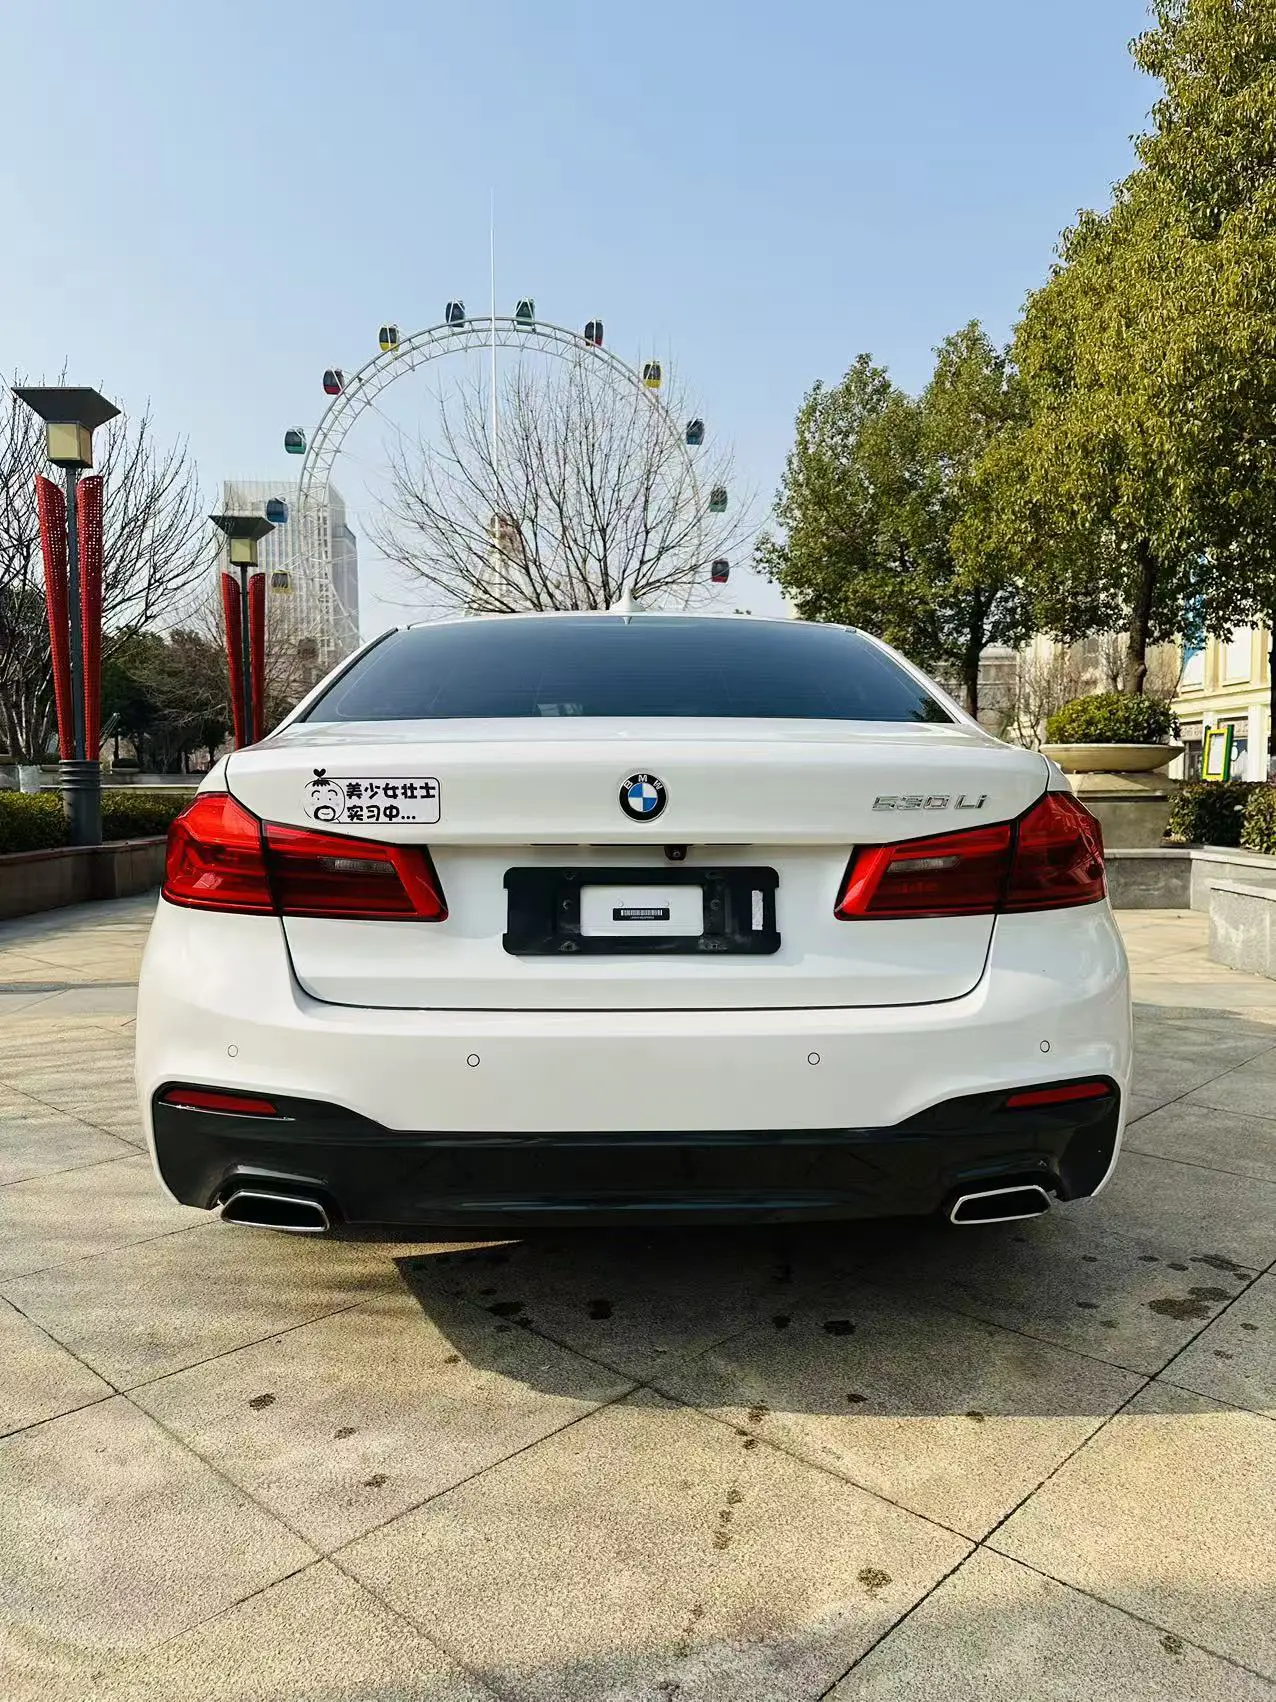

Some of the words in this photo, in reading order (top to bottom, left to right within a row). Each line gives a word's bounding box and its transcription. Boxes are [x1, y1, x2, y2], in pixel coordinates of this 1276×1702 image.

[623, 774, 663, 790] BMW
[346, 782, 436, 799] 美少女壮士
